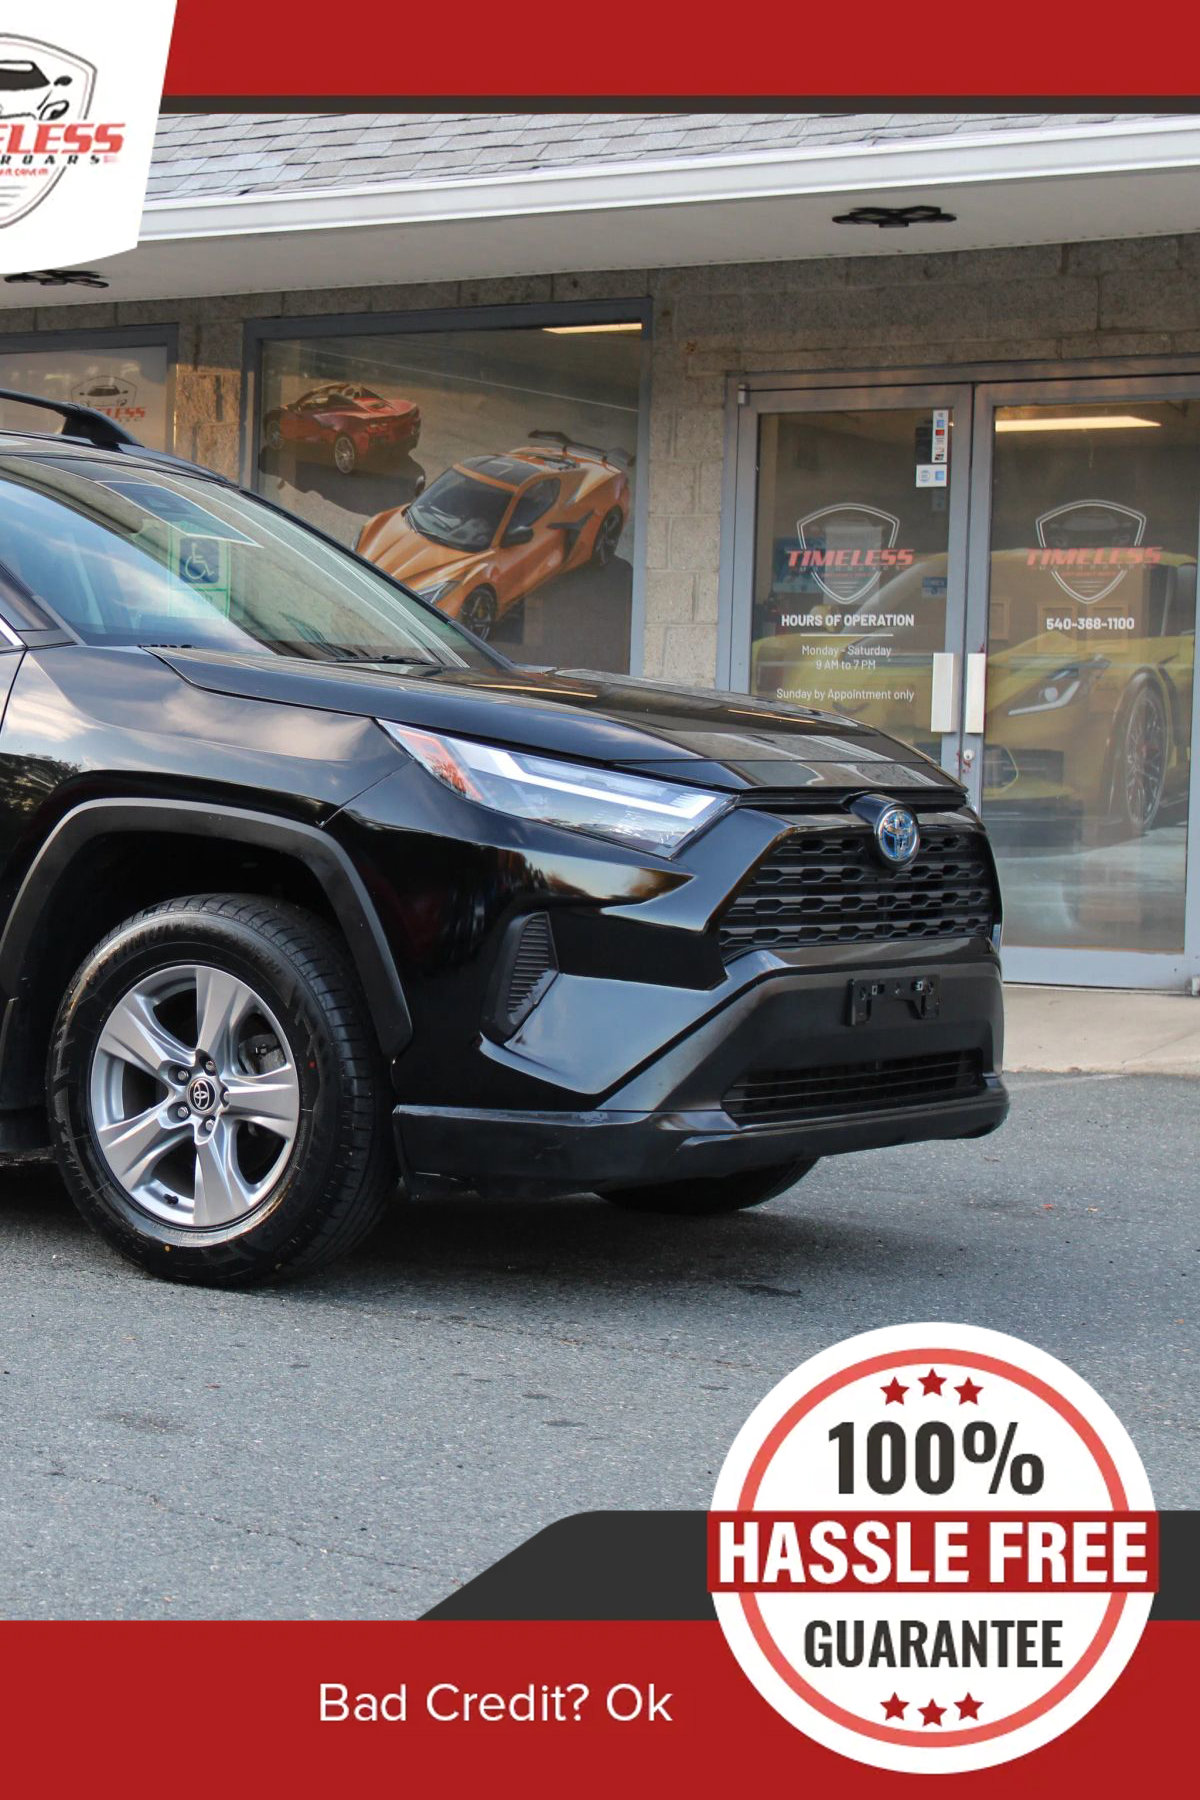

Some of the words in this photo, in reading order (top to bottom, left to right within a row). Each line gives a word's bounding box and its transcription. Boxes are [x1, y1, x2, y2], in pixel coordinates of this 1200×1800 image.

[785, 548, 915, 567] TIMELESS
[1025, 547, 1163, 566] TIMELESS
[781, 614, 823, 627] HOURS
[825, 614, 842, 627] OF
[843, 613, 915, 627] OPERATION
[1046, 617, 1135, 630] 540-368-1100
[801, 645, 839, 657] Monday
[847, 645, 892, 657] Saturday
[815, 659, 821, 671] 9
[823, 659, 839, 670] AM
[841, 660, 852, 670] to
[853, 659, 859, 670] 7
[861, 659, 876, 670] PM
[776, 688, 812, 701] Sunday
[814, 688, 826, 702] by
[827, 689, 892, 702] Appointment
[893, 690, 915, 703] only
